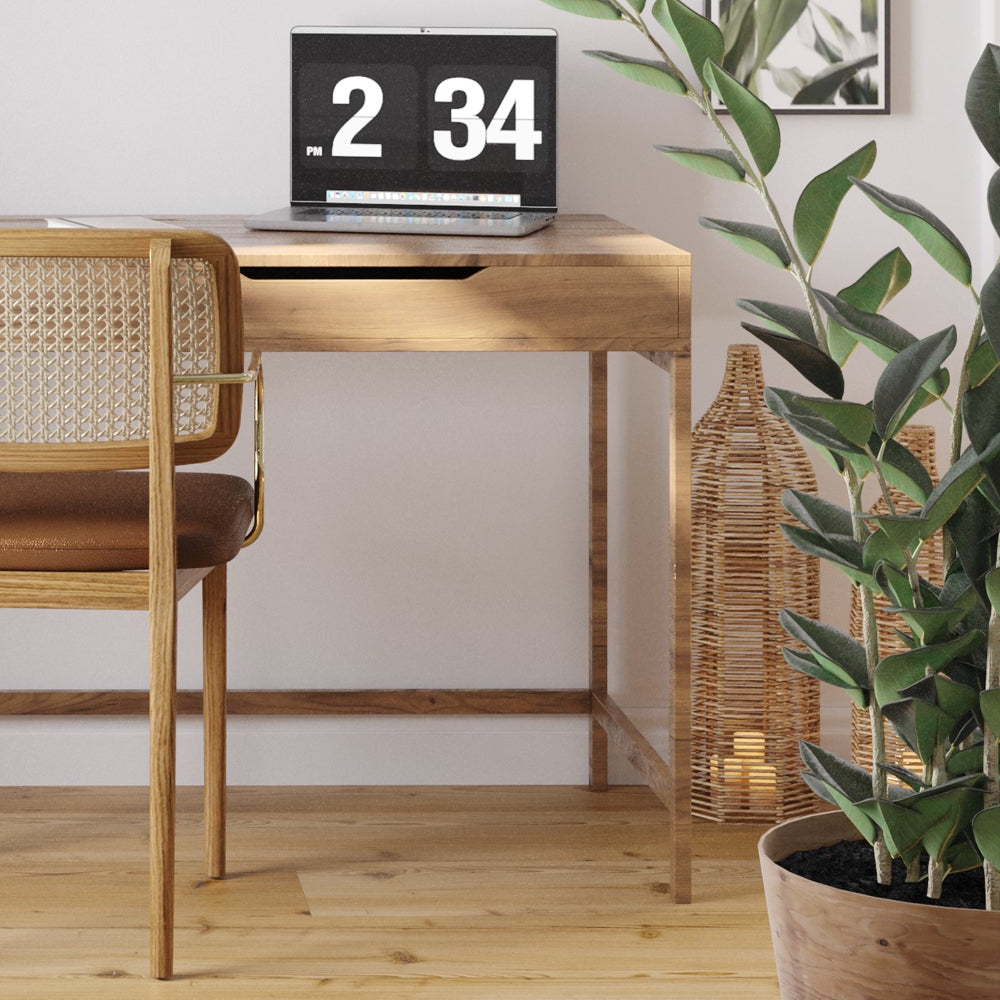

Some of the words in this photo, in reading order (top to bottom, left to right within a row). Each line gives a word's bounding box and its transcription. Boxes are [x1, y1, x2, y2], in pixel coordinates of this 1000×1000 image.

[306, 146, 322, 156] PM
[331, 76, 384, 158] 2
[433, 76, 543, 161] 34
